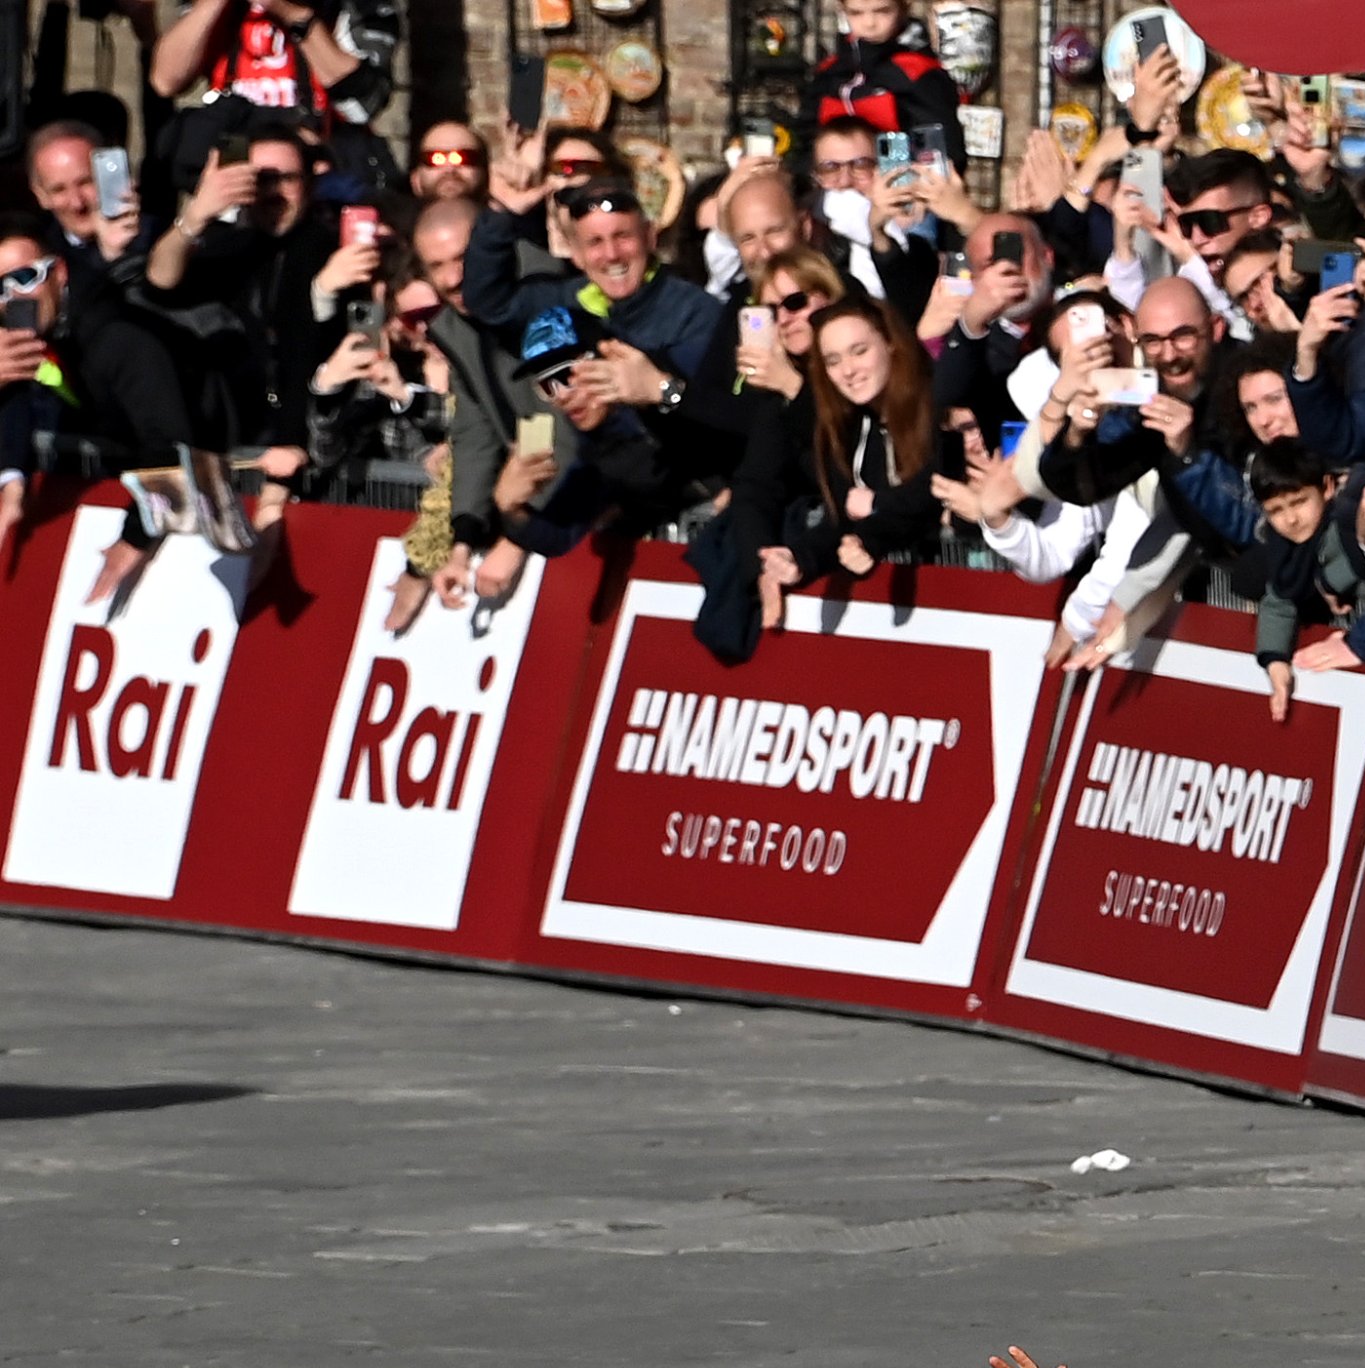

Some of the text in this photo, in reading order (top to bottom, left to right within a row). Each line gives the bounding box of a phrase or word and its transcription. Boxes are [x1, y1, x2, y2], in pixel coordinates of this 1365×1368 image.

[49, 624, 213, 780] Rai
[339, 655, 498, 811] Rai
[661, 811, 848, 876] SUPERFOOD
[1098, 870, 1225, 938] SUPERFOOD
